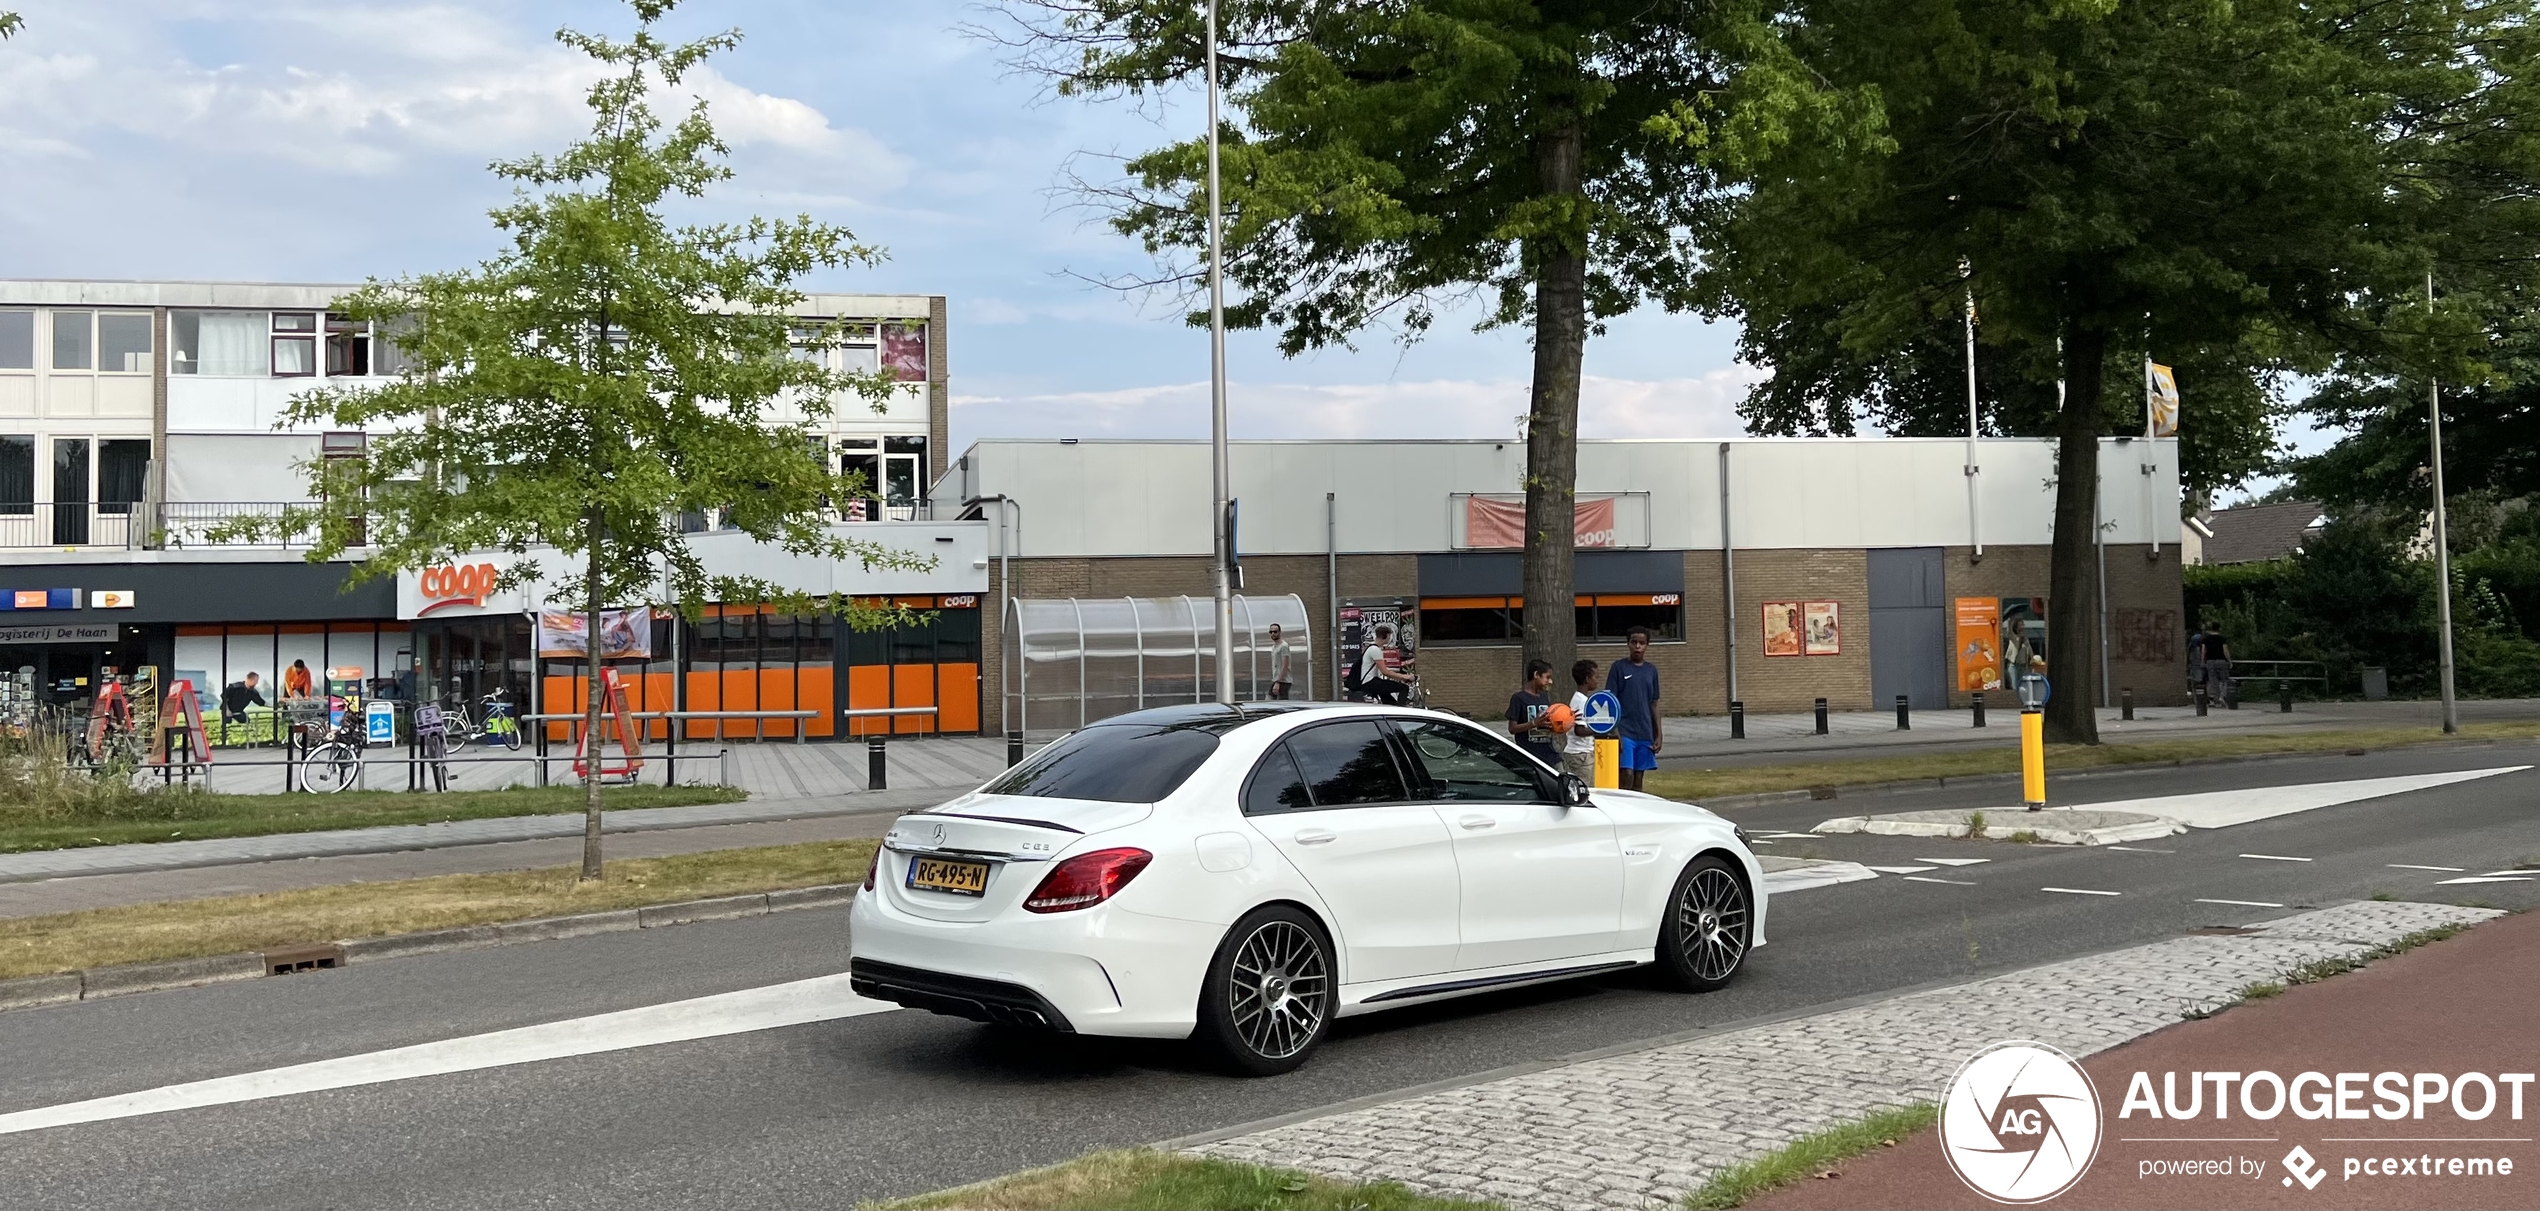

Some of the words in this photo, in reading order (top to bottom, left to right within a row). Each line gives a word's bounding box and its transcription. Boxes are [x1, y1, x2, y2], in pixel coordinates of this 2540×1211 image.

[1575, 528, 1615, 547] coop
[421, 563, 496, 607] coop
[945, 596, 975, 607] coop
[1652, 594, 1678, 605] coop
[57, 628, 73, 638] De
[76, 628, 108, 638] Haan
[917, 861, 983, 887] RG-495-N
